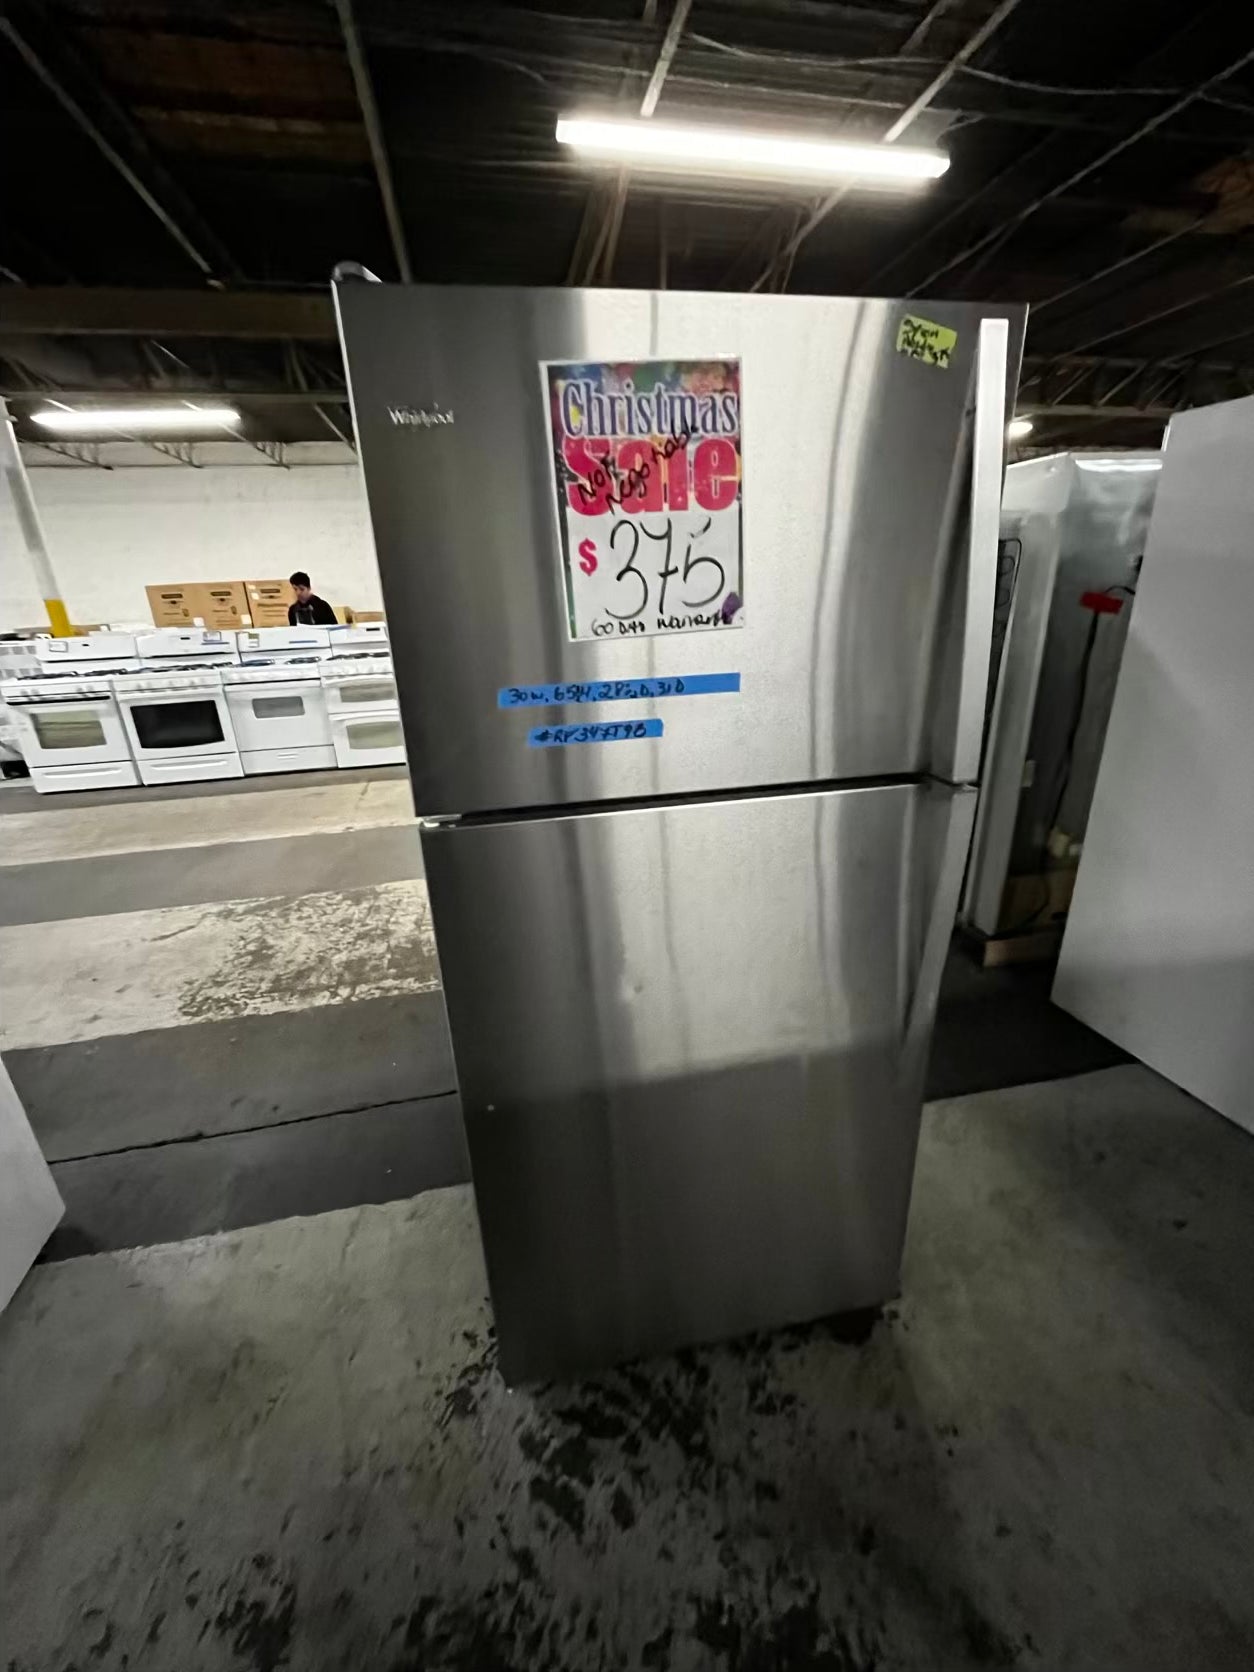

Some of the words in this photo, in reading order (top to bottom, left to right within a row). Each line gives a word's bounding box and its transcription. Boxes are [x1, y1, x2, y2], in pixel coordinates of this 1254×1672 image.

[561, 377, 738, 437] Christmas
[561, 437, 741, 516] Sale
[591, 618, 614, 637] 60
